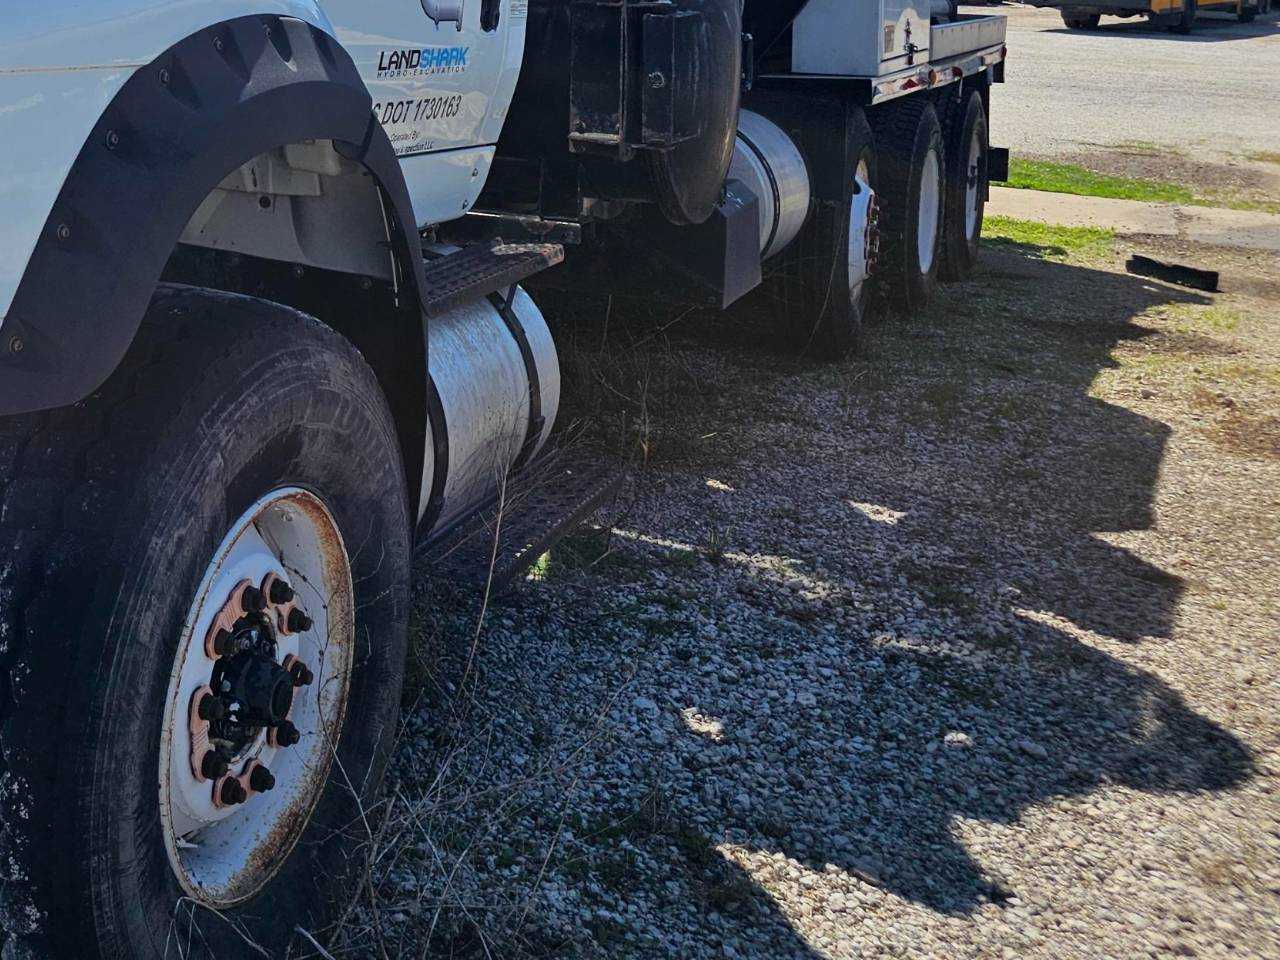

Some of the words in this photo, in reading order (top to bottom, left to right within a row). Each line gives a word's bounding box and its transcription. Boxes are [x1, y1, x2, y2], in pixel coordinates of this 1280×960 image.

[378, 46, 470, 71] LANDSHARK
[382, 100, 414, 126] DOT
[414, 95, 462, 122] 1730163
